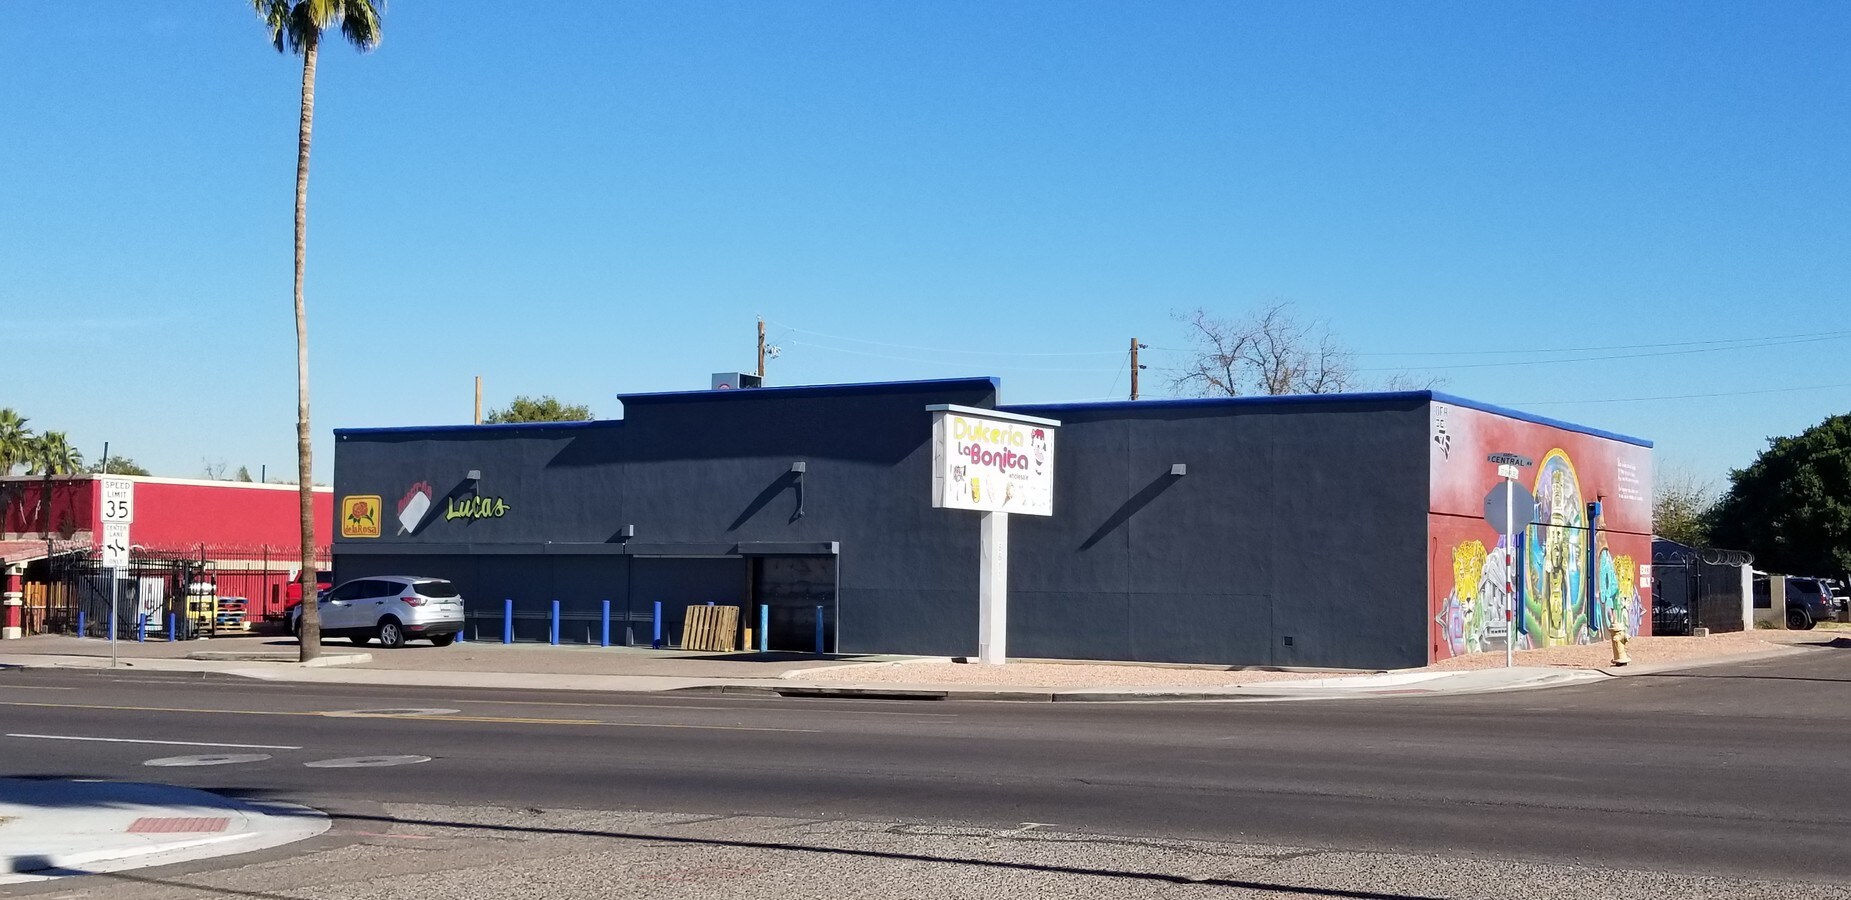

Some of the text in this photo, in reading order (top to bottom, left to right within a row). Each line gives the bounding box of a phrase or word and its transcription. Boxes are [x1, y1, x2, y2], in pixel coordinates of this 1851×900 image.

[954, 417, 1024, 447] Dulceria
[970, 443, 1029, 473] Bonita
[1491, 456, 1525, 466] CENTRAL
[105, 481, 130, 489] SPEED
[107, 491, 127, 499] LIMIT
[105, 500, 128, 518] 35
[444, 495, 511, 522] Lucas
[357, 524, 377, 533] Rosa
